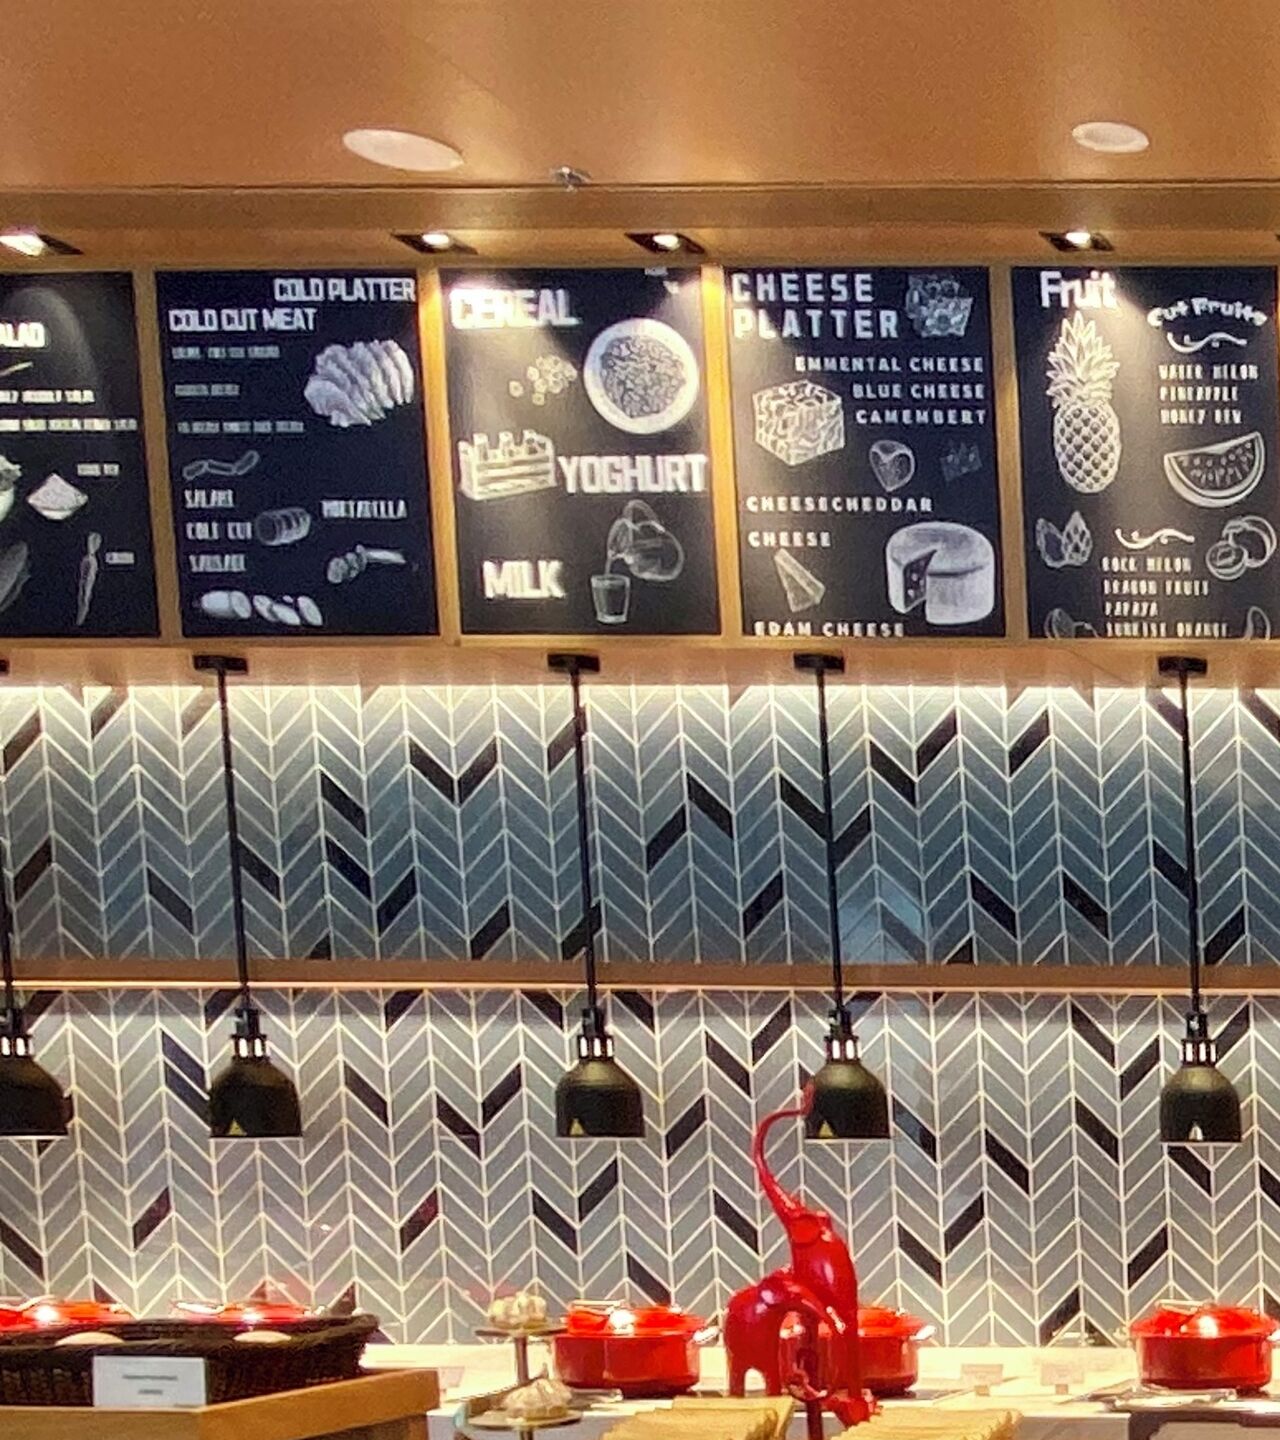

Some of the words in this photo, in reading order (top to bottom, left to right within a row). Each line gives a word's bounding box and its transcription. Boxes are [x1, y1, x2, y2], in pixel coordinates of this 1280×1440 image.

[274, 278, 323, 300] COLD
[329, 278, 416, 301] PLATTER
[731, 273, 874, 303] CHEESE
[1040, 270, 1119, 308] Fruit
[169, 309, 218, 331] COLD
[221, 309, 259, 331] CUT
[262, 308, 317, 331] MEAT
[450, 288, 582, 328] CEREAL
[1147, 300, 1188, 327] Cut
[1191, 297, 1267, 326] Fruits
[732, 308, 899, 339] PLATTER
[794, 357, 901, 372] EMMENTAL
[909, 357, 983, 372] CHEESE
[852, 383, 901, 399] BLUE
[911, 383, 985, 399] CHEESE
[856, 409, 986, 425] CAMEMBERT
[559, 454, 707, 493] YOGHURT
[748, 531, 831, 547] CHEESE
[484, 561, 565, 598] MILK
[754, 622, 811, 636] EDAM
[822, 622, 904, 637] CHEESE
